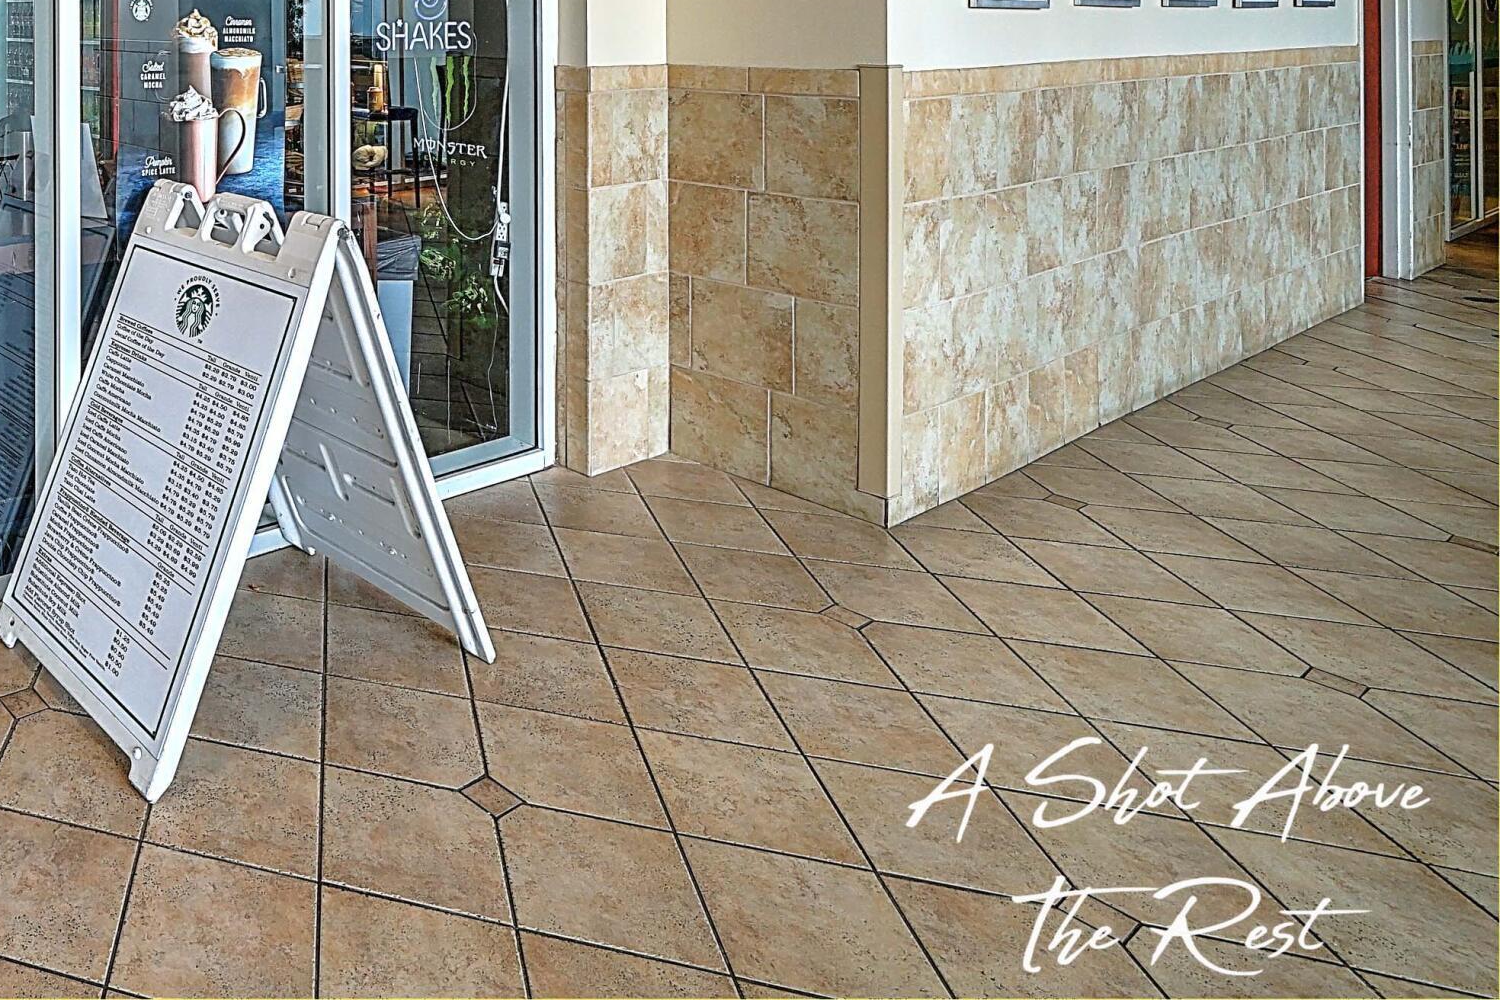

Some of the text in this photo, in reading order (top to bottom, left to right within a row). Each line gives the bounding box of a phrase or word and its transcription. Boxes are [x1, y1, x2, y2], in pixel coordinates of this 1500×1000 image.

[376, 21, 471, 51] SHAKES
[413, 137, 488, 159] MONSTER
[142, 168, 157, 177] SPICE
